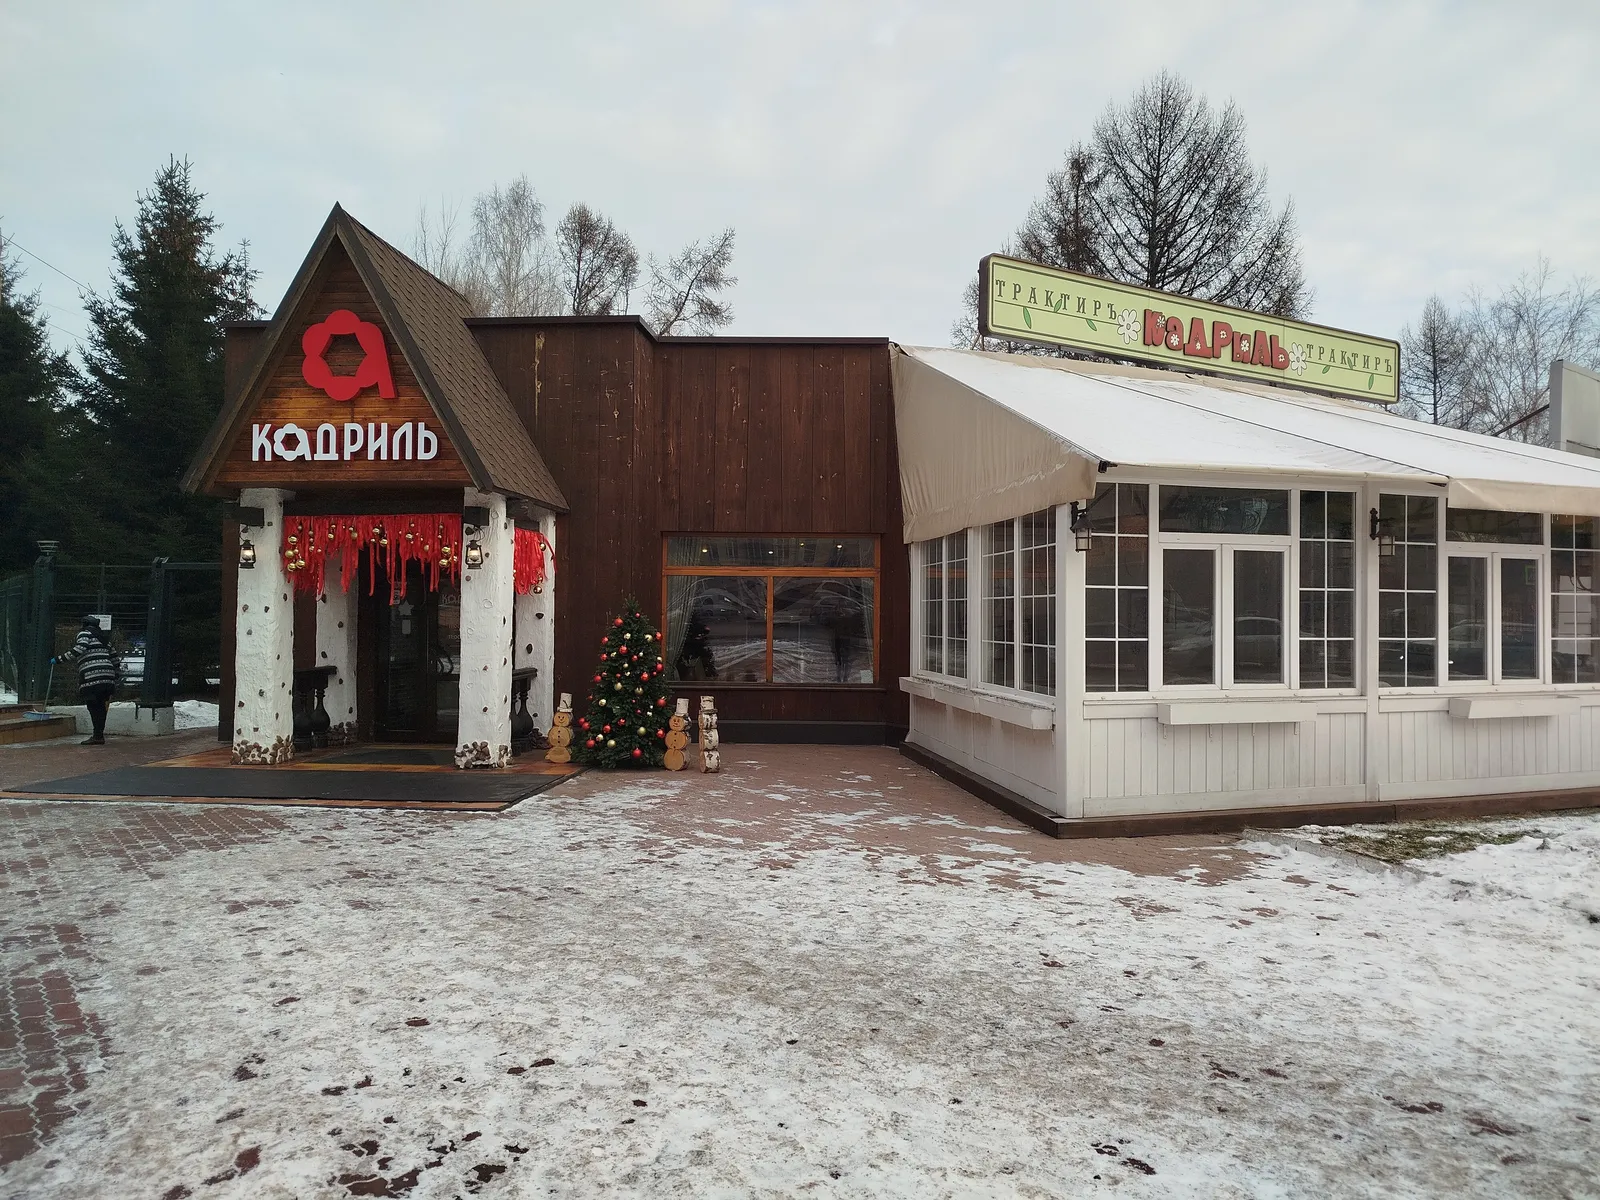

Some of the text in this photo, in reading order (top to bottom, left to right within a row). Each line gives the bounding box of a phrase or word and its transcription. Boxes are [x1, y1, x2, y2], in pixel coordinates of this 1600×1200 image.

[995, 279, 1118, 320] ТРАКТИРЪ
[1306, 343, 1392, 373] ТРАКТИРЪ
[252, 422, 438, 462] КАДРИЛЬ
